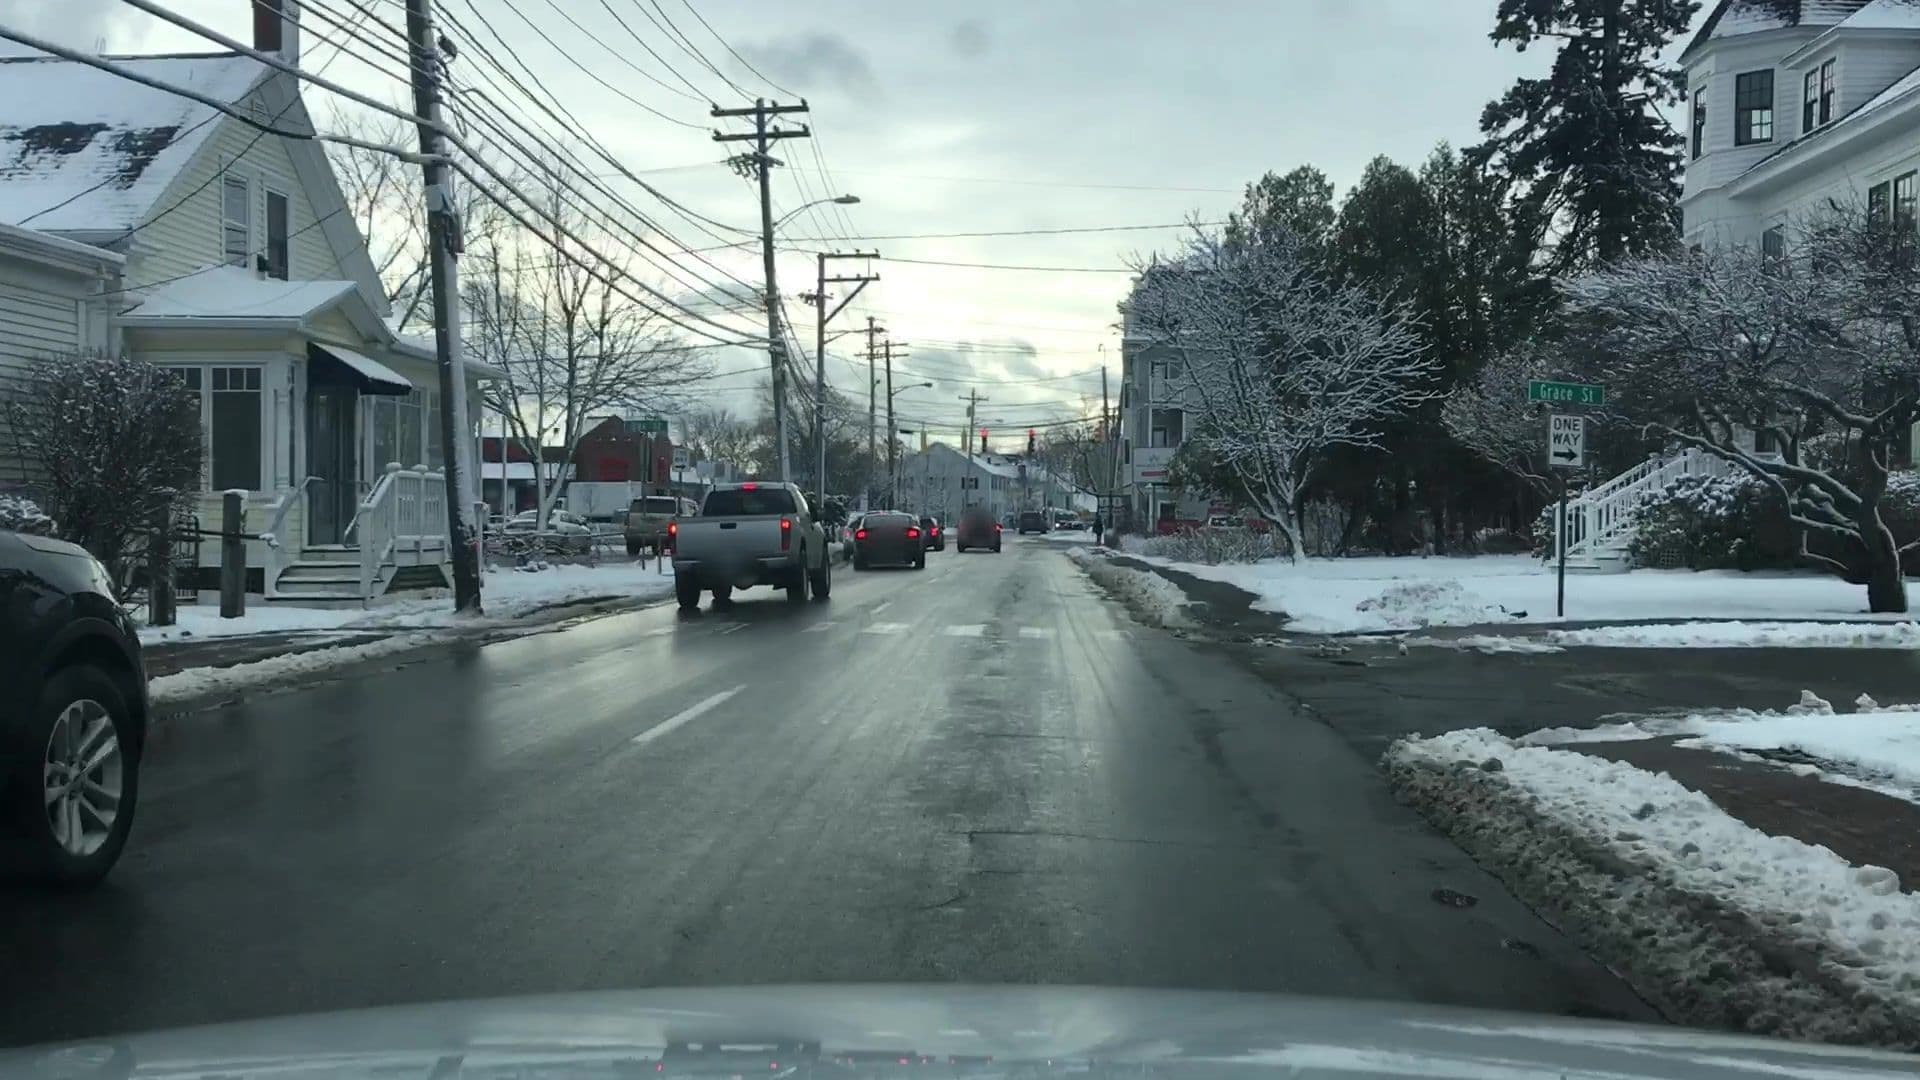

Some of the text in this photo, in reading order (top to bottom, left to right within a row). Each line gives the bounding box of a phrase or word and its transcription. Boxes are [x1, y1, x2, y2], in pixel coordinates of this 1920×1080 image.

[1540, 383, 1594, 403] Grace St
[1553, 417, 1580, 431] ONE
[1553, 433, 1580, 446] WAY
